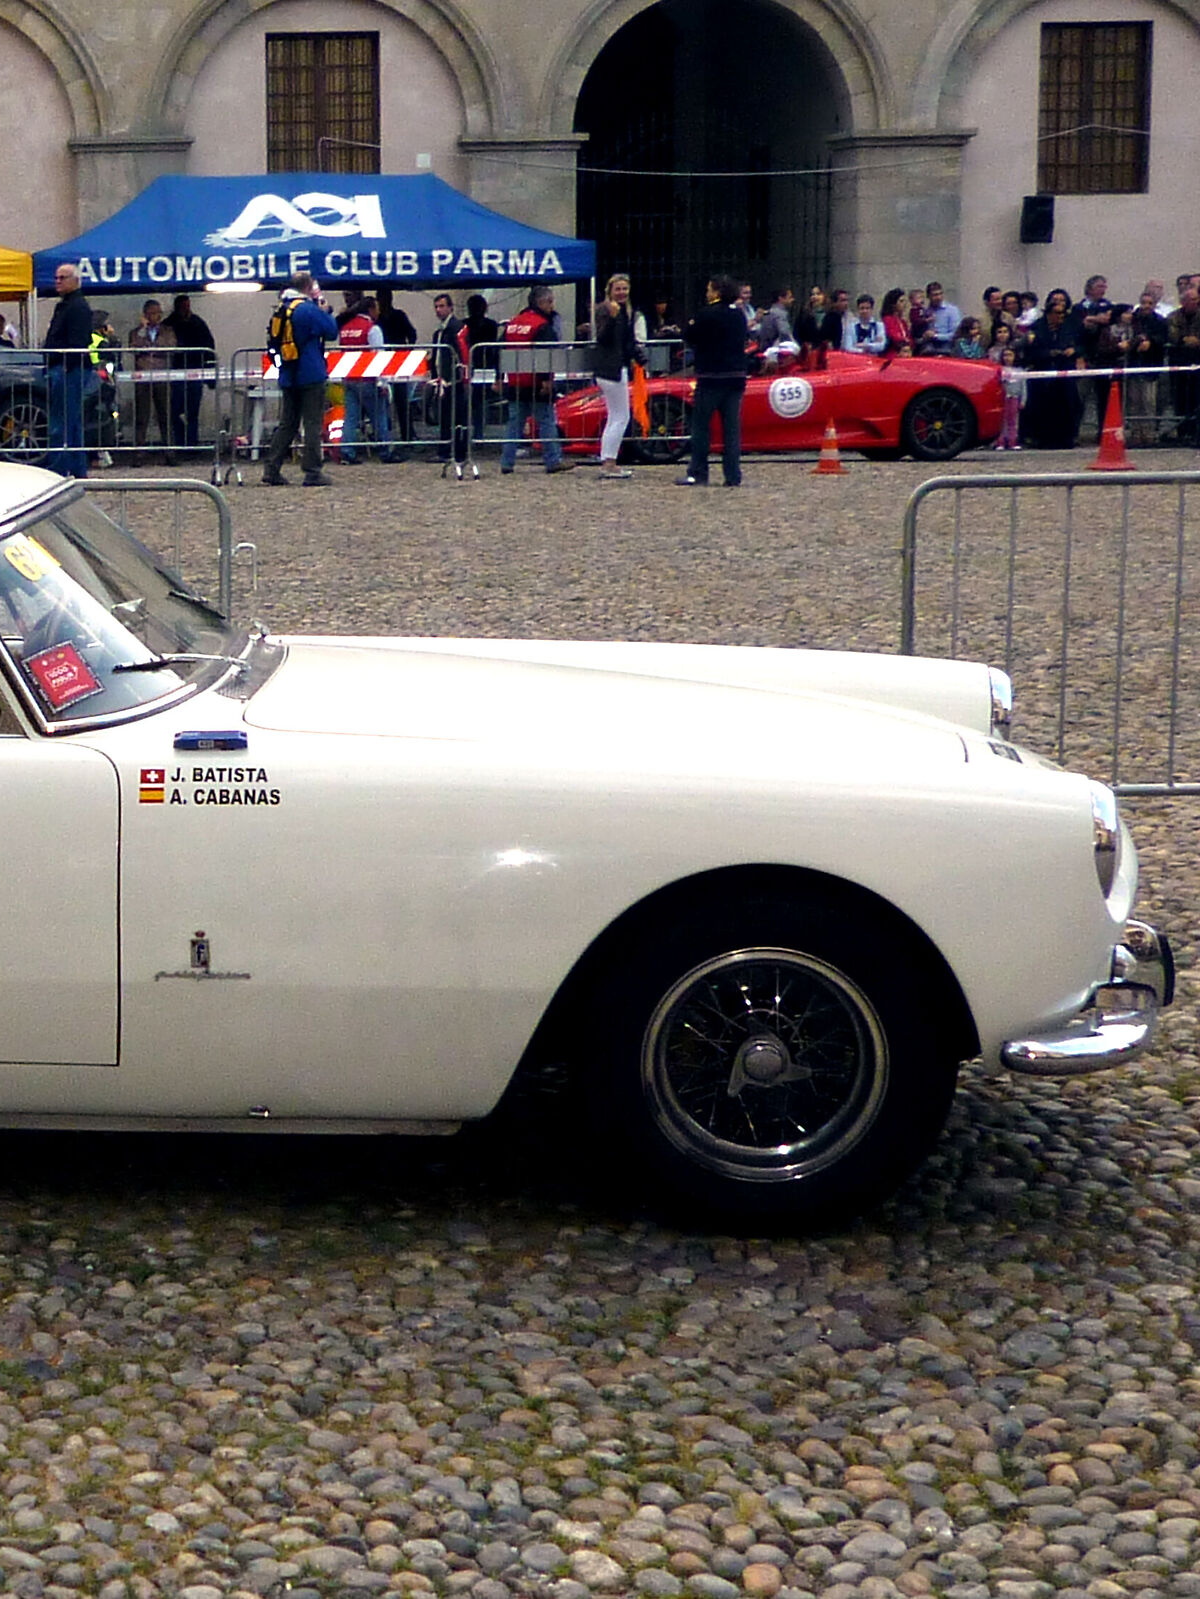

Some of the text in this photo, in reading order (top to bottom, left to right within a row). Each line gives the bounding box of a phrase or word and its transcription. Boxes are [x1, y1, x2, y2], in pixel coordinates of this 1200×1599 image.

[79, 249, 564, 283] AUTOMOBILE CLUB PARMA
[780, 386, 801, 401] 555
[171, 767, 268, 782] J. BATISTA
[170, 789, 281, 804] A. CABANAS
